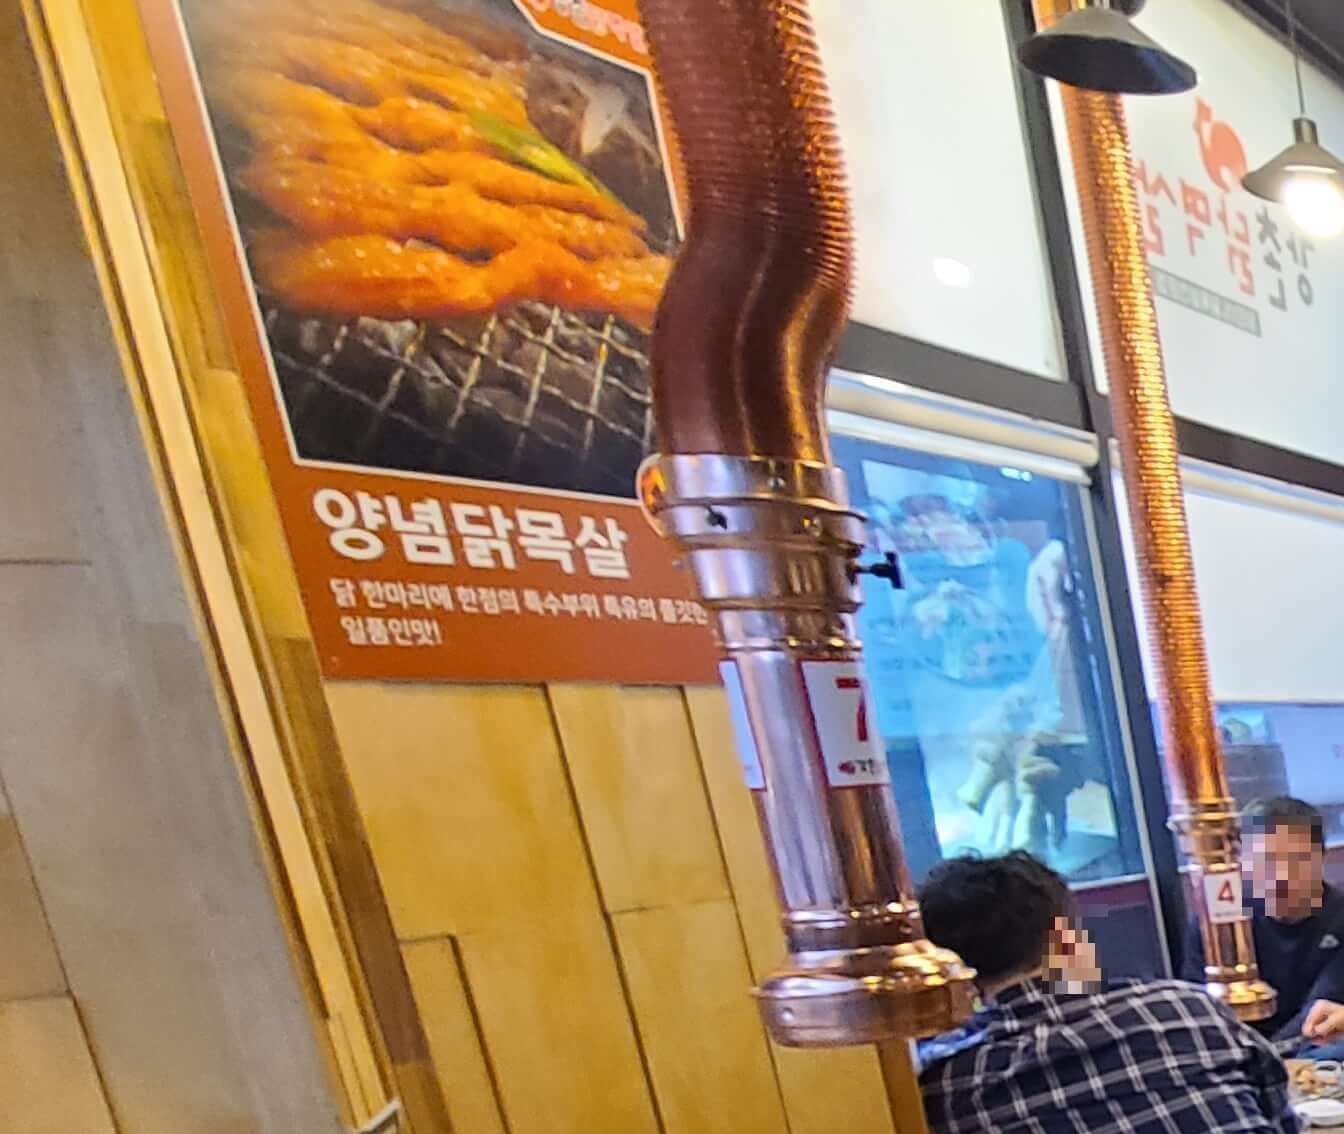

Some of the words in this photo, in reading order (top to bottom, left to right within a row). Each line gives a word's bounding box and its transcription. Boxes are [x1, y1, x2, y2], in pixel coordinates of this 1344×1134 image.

[313, 488, 631, 579] 양념닭목살
[329, 577, 356, 608] 닭
[360, 580, 453, 611] 한마리에
[835, 677, 868, 742] 7
[1217, 879, 1235, 905] 4
